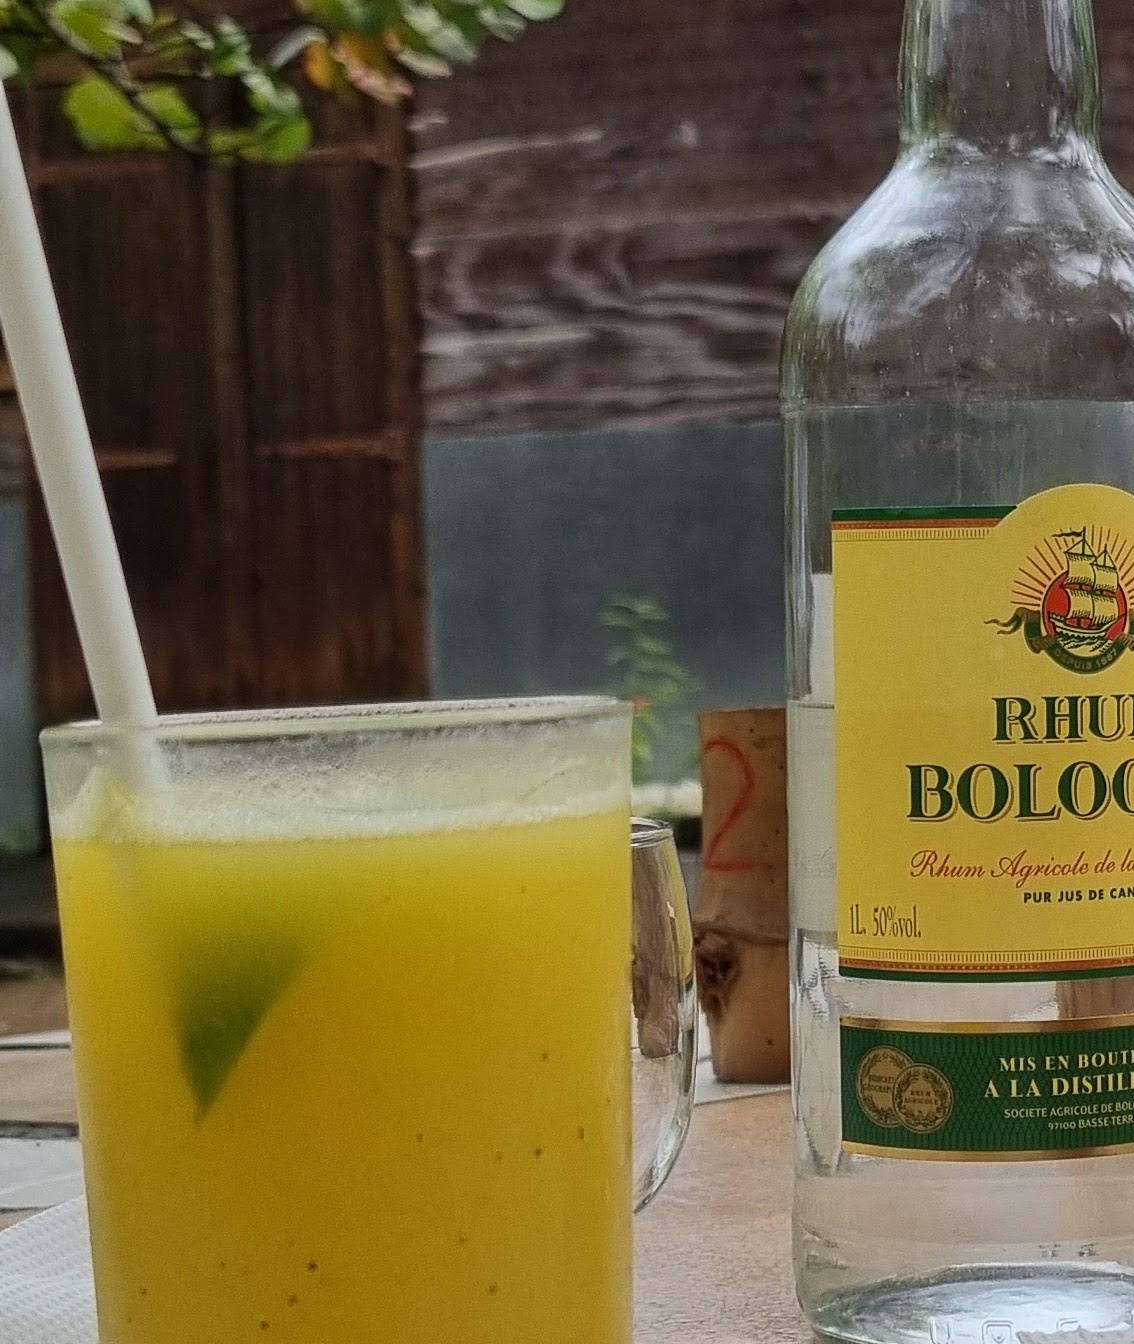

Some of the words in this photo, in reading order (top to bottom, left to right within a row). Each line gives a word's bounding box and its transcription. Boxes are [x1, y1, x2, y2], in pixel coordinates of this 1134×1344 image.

[704, 738, 769, 871] 2
[910, 849, 986, 878] Rhum
[990, 849, 1089, 888] Agricole
[1093, 849, 1116, 874] de
[1023, 890, 1052, 904] PUR
[1058, 889, 1083, 903] JUS
[1088, 888, 1105, 901] DE
[999, 1056, 1037, 1072] MIS
[1045, 1055, 1070, 1071] EN
[984, 1079, 1000, 1098] A
[1010, 1078, 1042, 1098] LA
[1004, 1107, 1048, 1119] SOCIETE
[1050, 1104, 1099, 1117] AGRICOLE
[1101, 1102, 1113, 1114] DE
[1047, 1121, 1076, 1131] 97100
